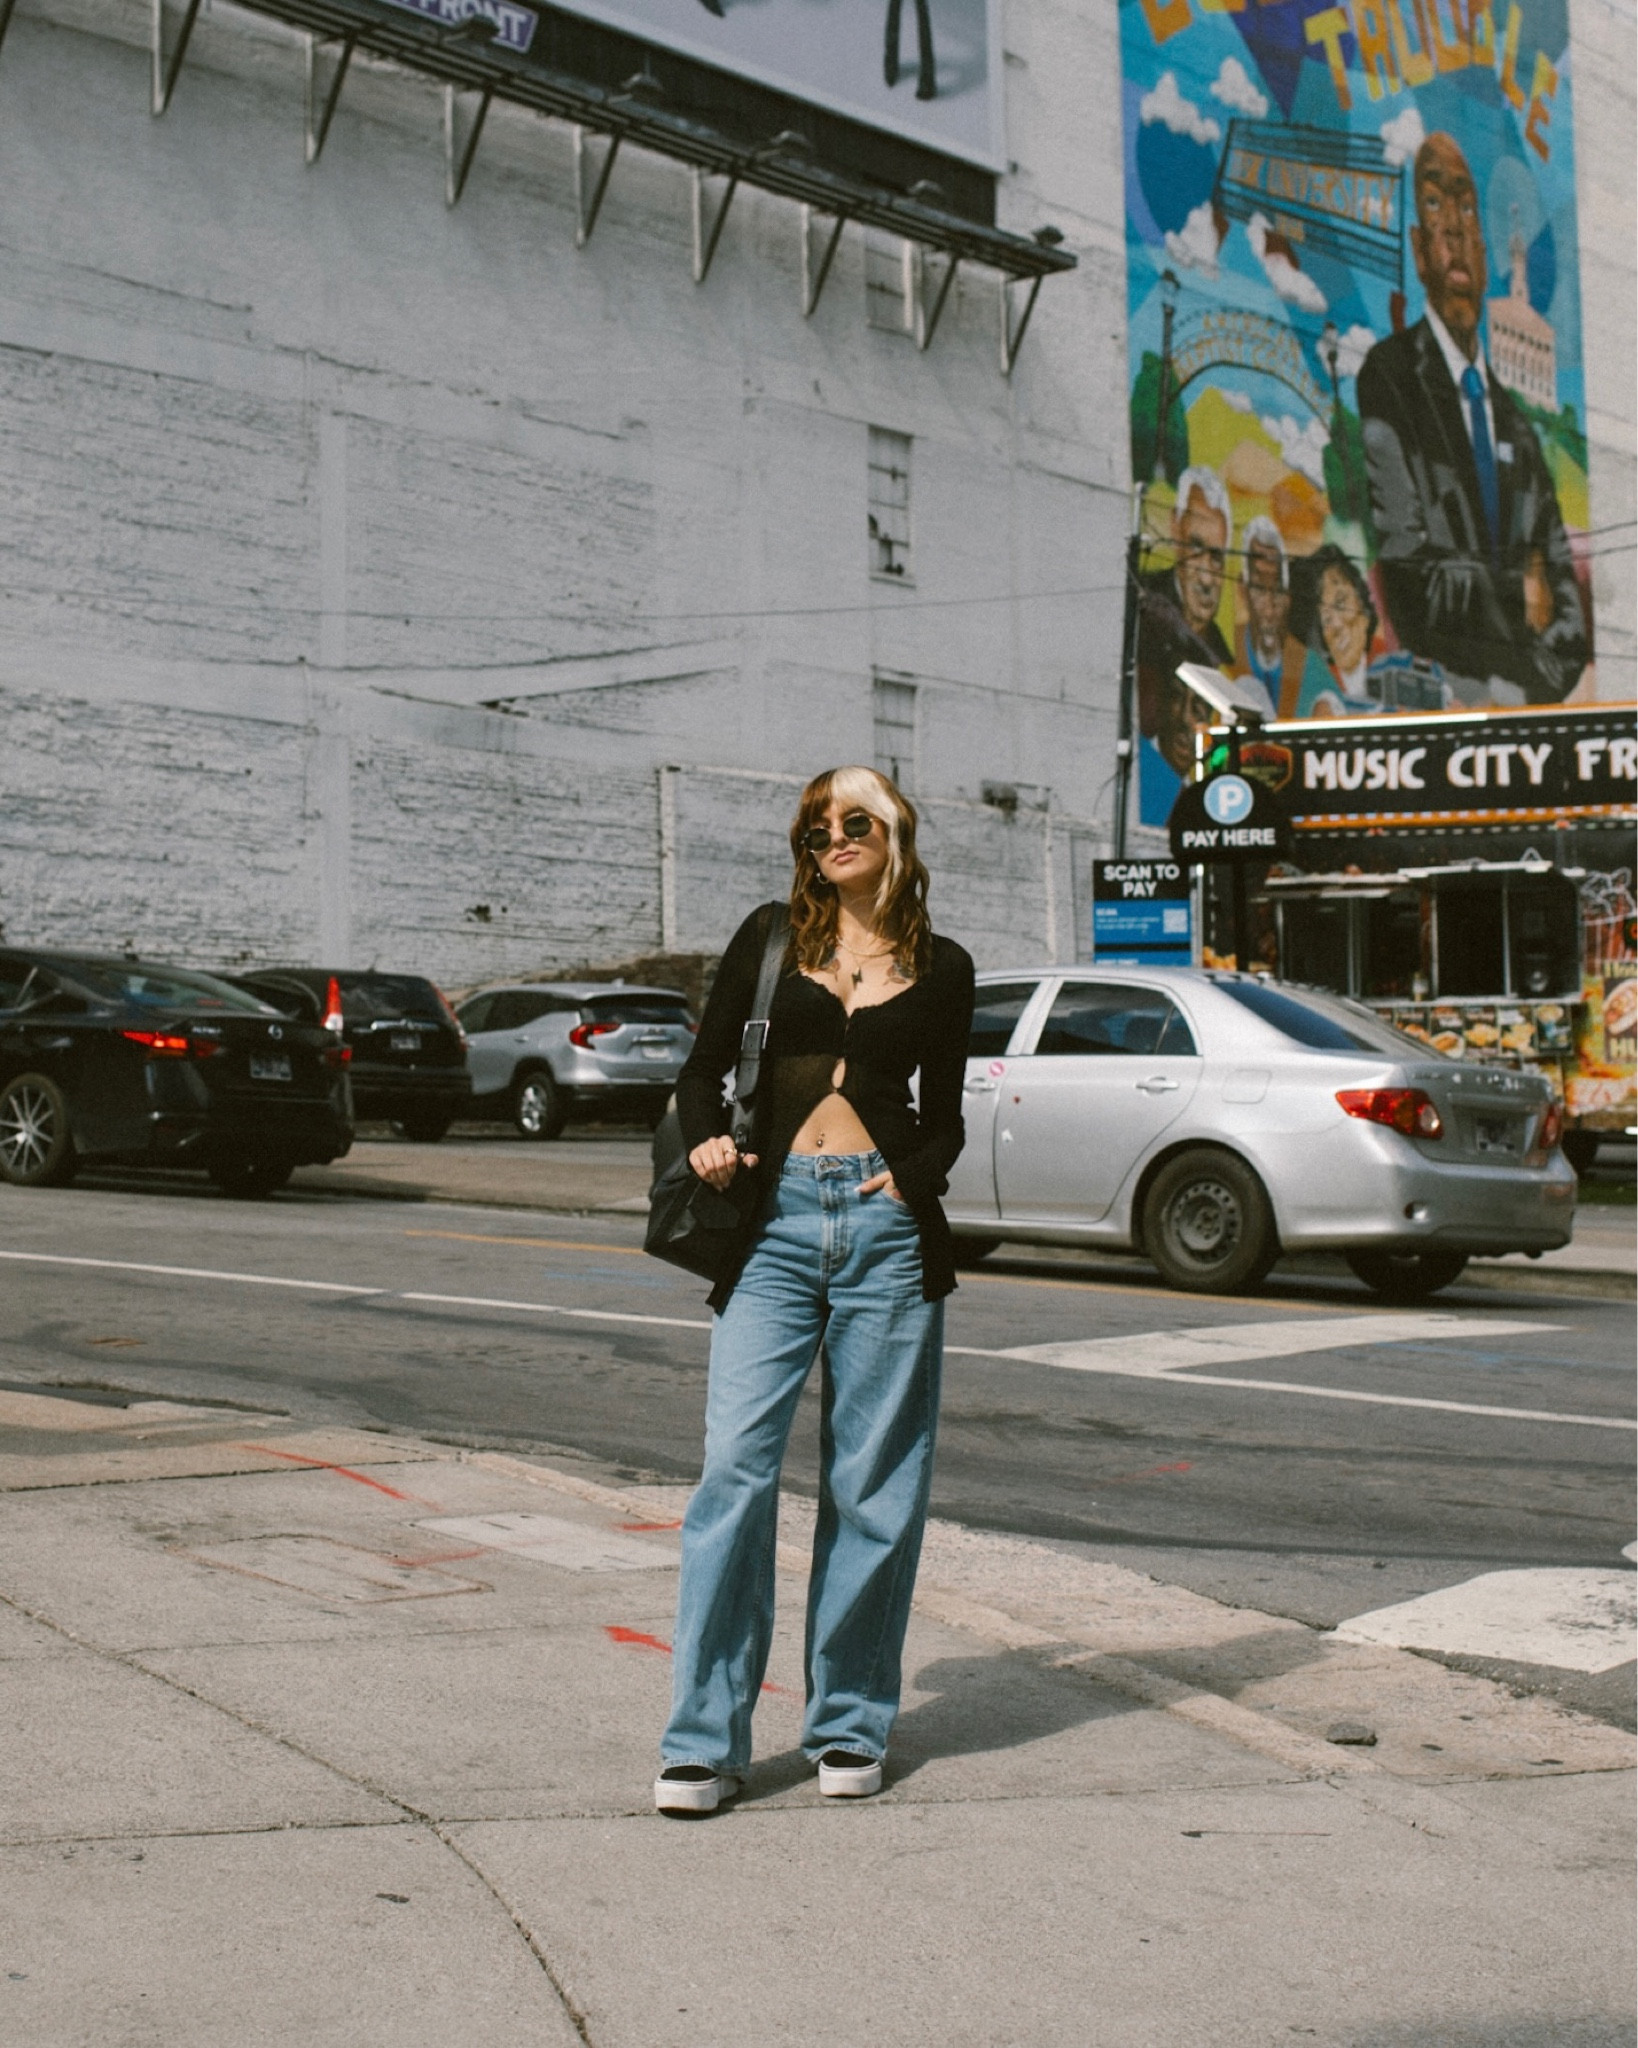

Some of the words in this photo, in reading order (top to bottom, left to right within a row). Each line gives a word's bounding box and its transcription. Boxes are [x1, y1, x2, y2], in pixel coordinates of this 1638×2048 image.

[1304, 748, 1427, 790] MUSIC
[1447, 743, 1552, 787] CITY
[1574, 737, 1637, 780] FR
[1218, 783, 1245, 816] P
[1182, 830, 1219, 847] PAY
[1222, 828, 1275, 846] HERE
[1104, 864, 1151, 881] SCAN
[1155, 864, 1180, 880] TO
[1123, 881, 1157, 897] PAY
